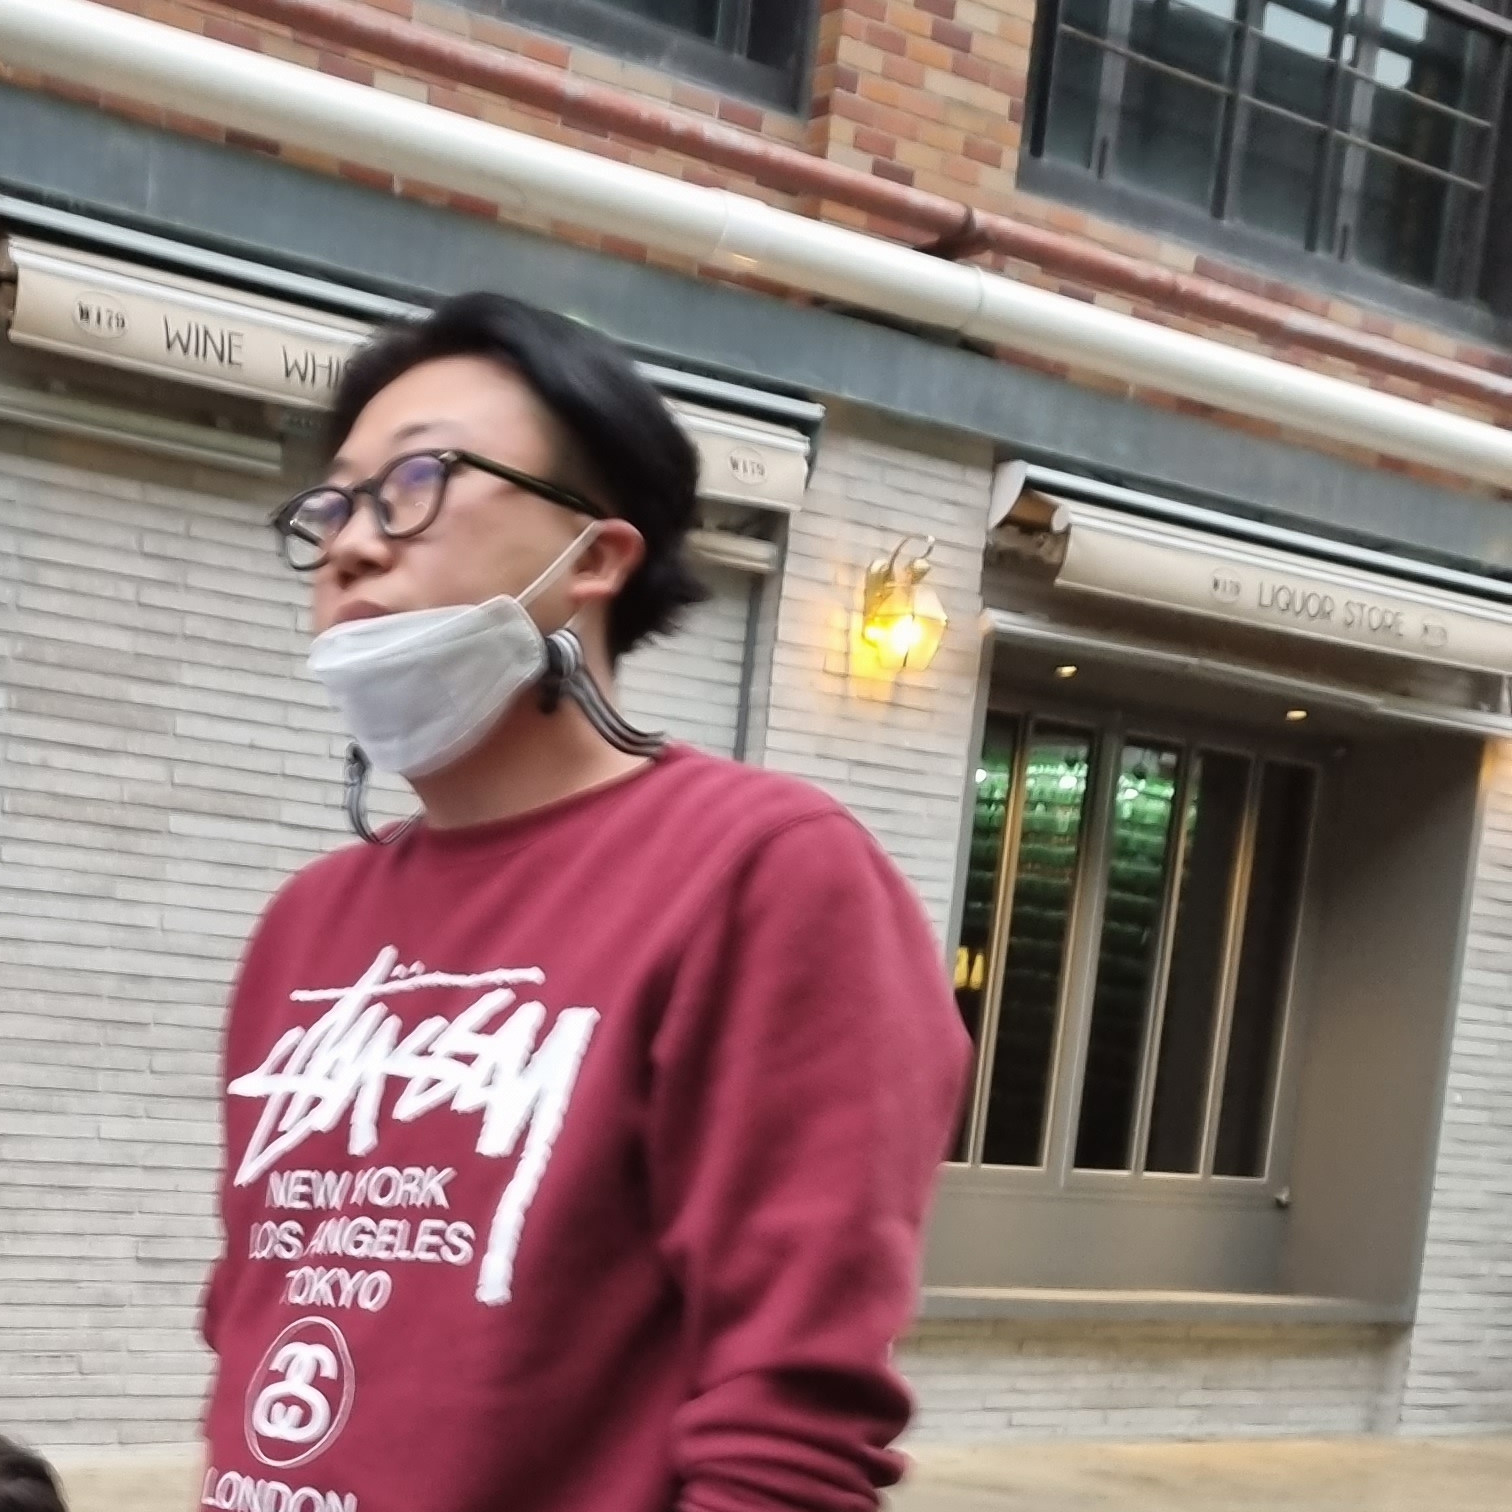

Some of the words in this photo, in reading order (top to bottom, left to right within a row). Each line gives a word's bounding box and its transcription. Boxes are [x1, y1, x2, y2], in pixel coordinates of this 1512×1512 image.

[163, 315, 245, 370] WINE
[1258, 581, 1335, 621] LIQUOR
[1344, 599, 1404, 637] STORE
[265, 1168, 355, 1212] NEW
[349, 1165, 458, 1211] YORK
[248, 1219, 306, 1262] LOS
[302, 1215, 477, 1267] ANGELES
[279, 1265, 393, 1313] TOKYO
